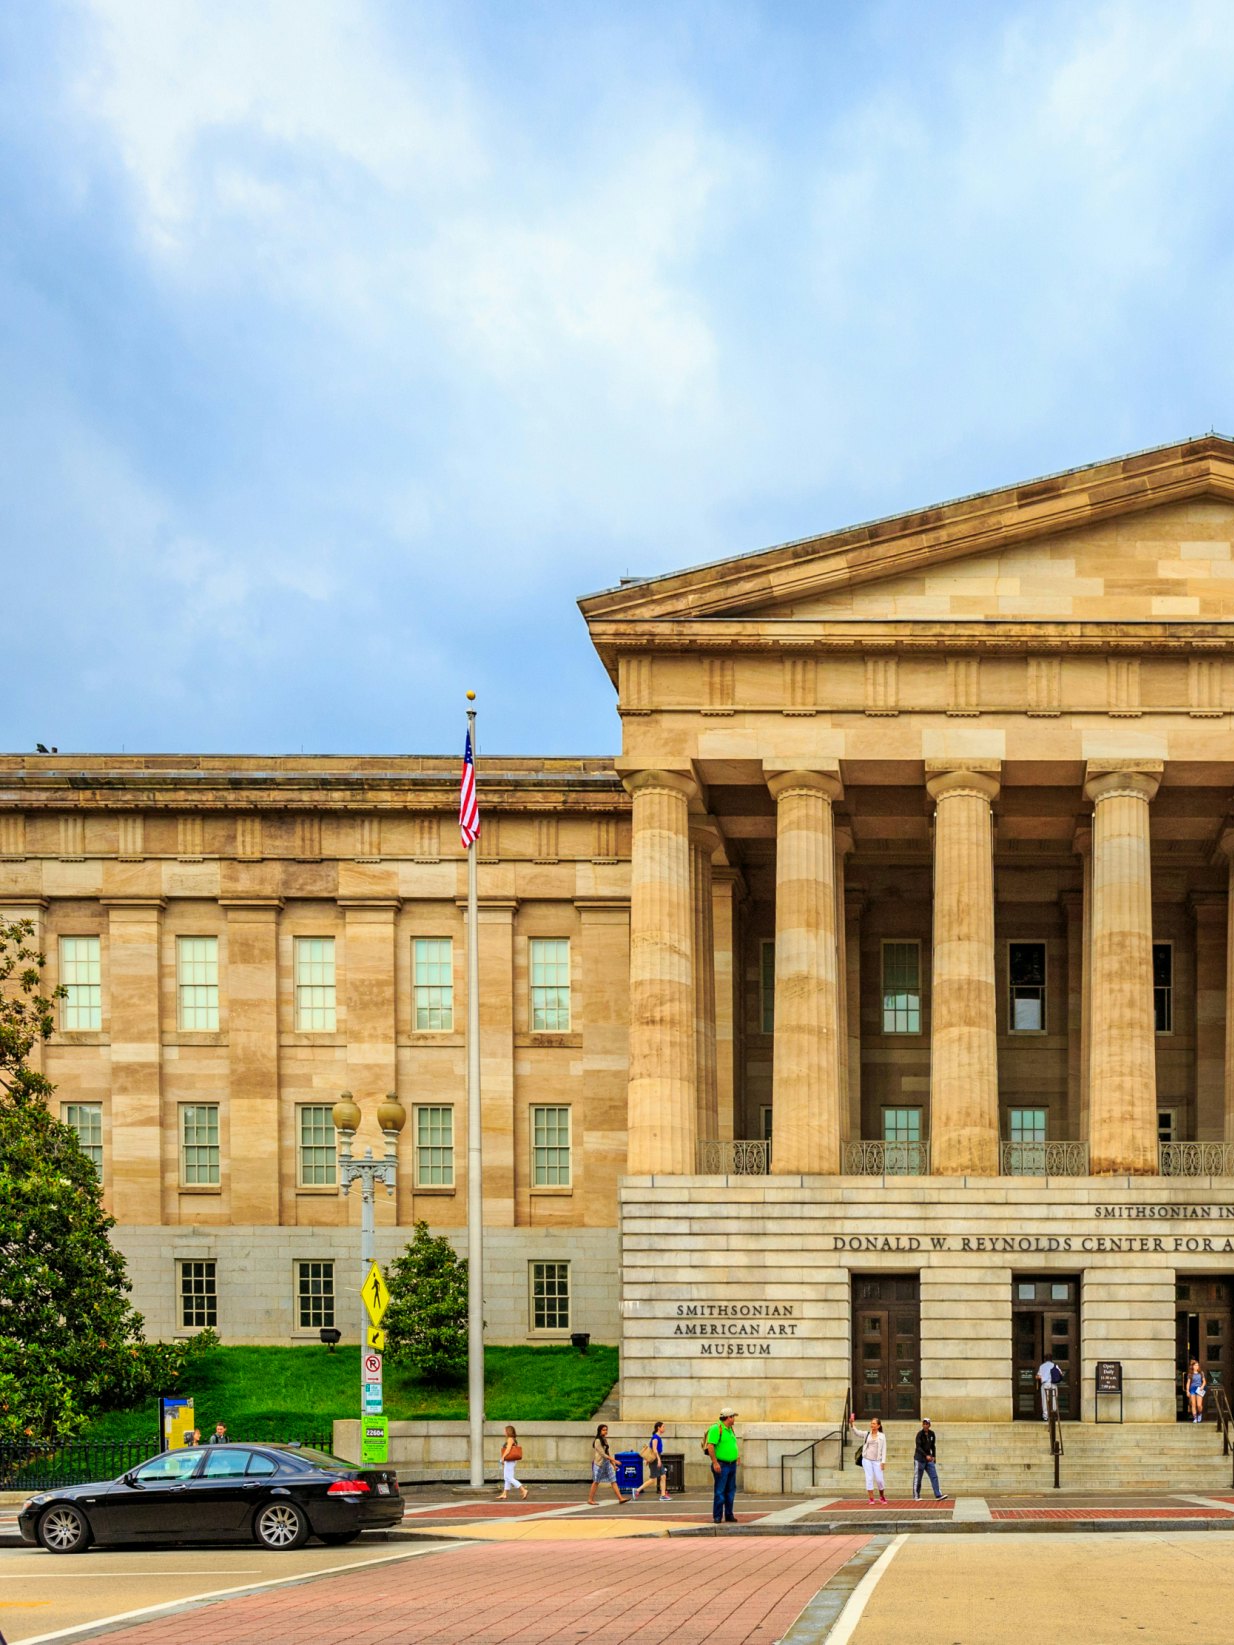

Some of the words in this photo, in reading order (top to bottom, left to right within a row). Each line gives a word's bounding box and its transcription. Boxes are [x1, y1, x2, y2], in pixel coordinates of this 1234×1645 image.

[1095, 1206, 1211, 1218] SMITHSONIAN
[833, 1237, 921, 1250] DONALD
[930, 1237, 951, 1250] W.
[961, 1237, 1072, 1251] REYNOLDS
[1081, 1238, 1166, 1251] CENTER
[1174, 1238, 1213, 1251] FOR
[677, 1305, 794, 1316] SMITHSONIAN
[674, 1324, 761, 1335] AMERICAN
[767, 1324, 798, 1335] ART
[700, 1344, 771, 1355] MUSEUM
